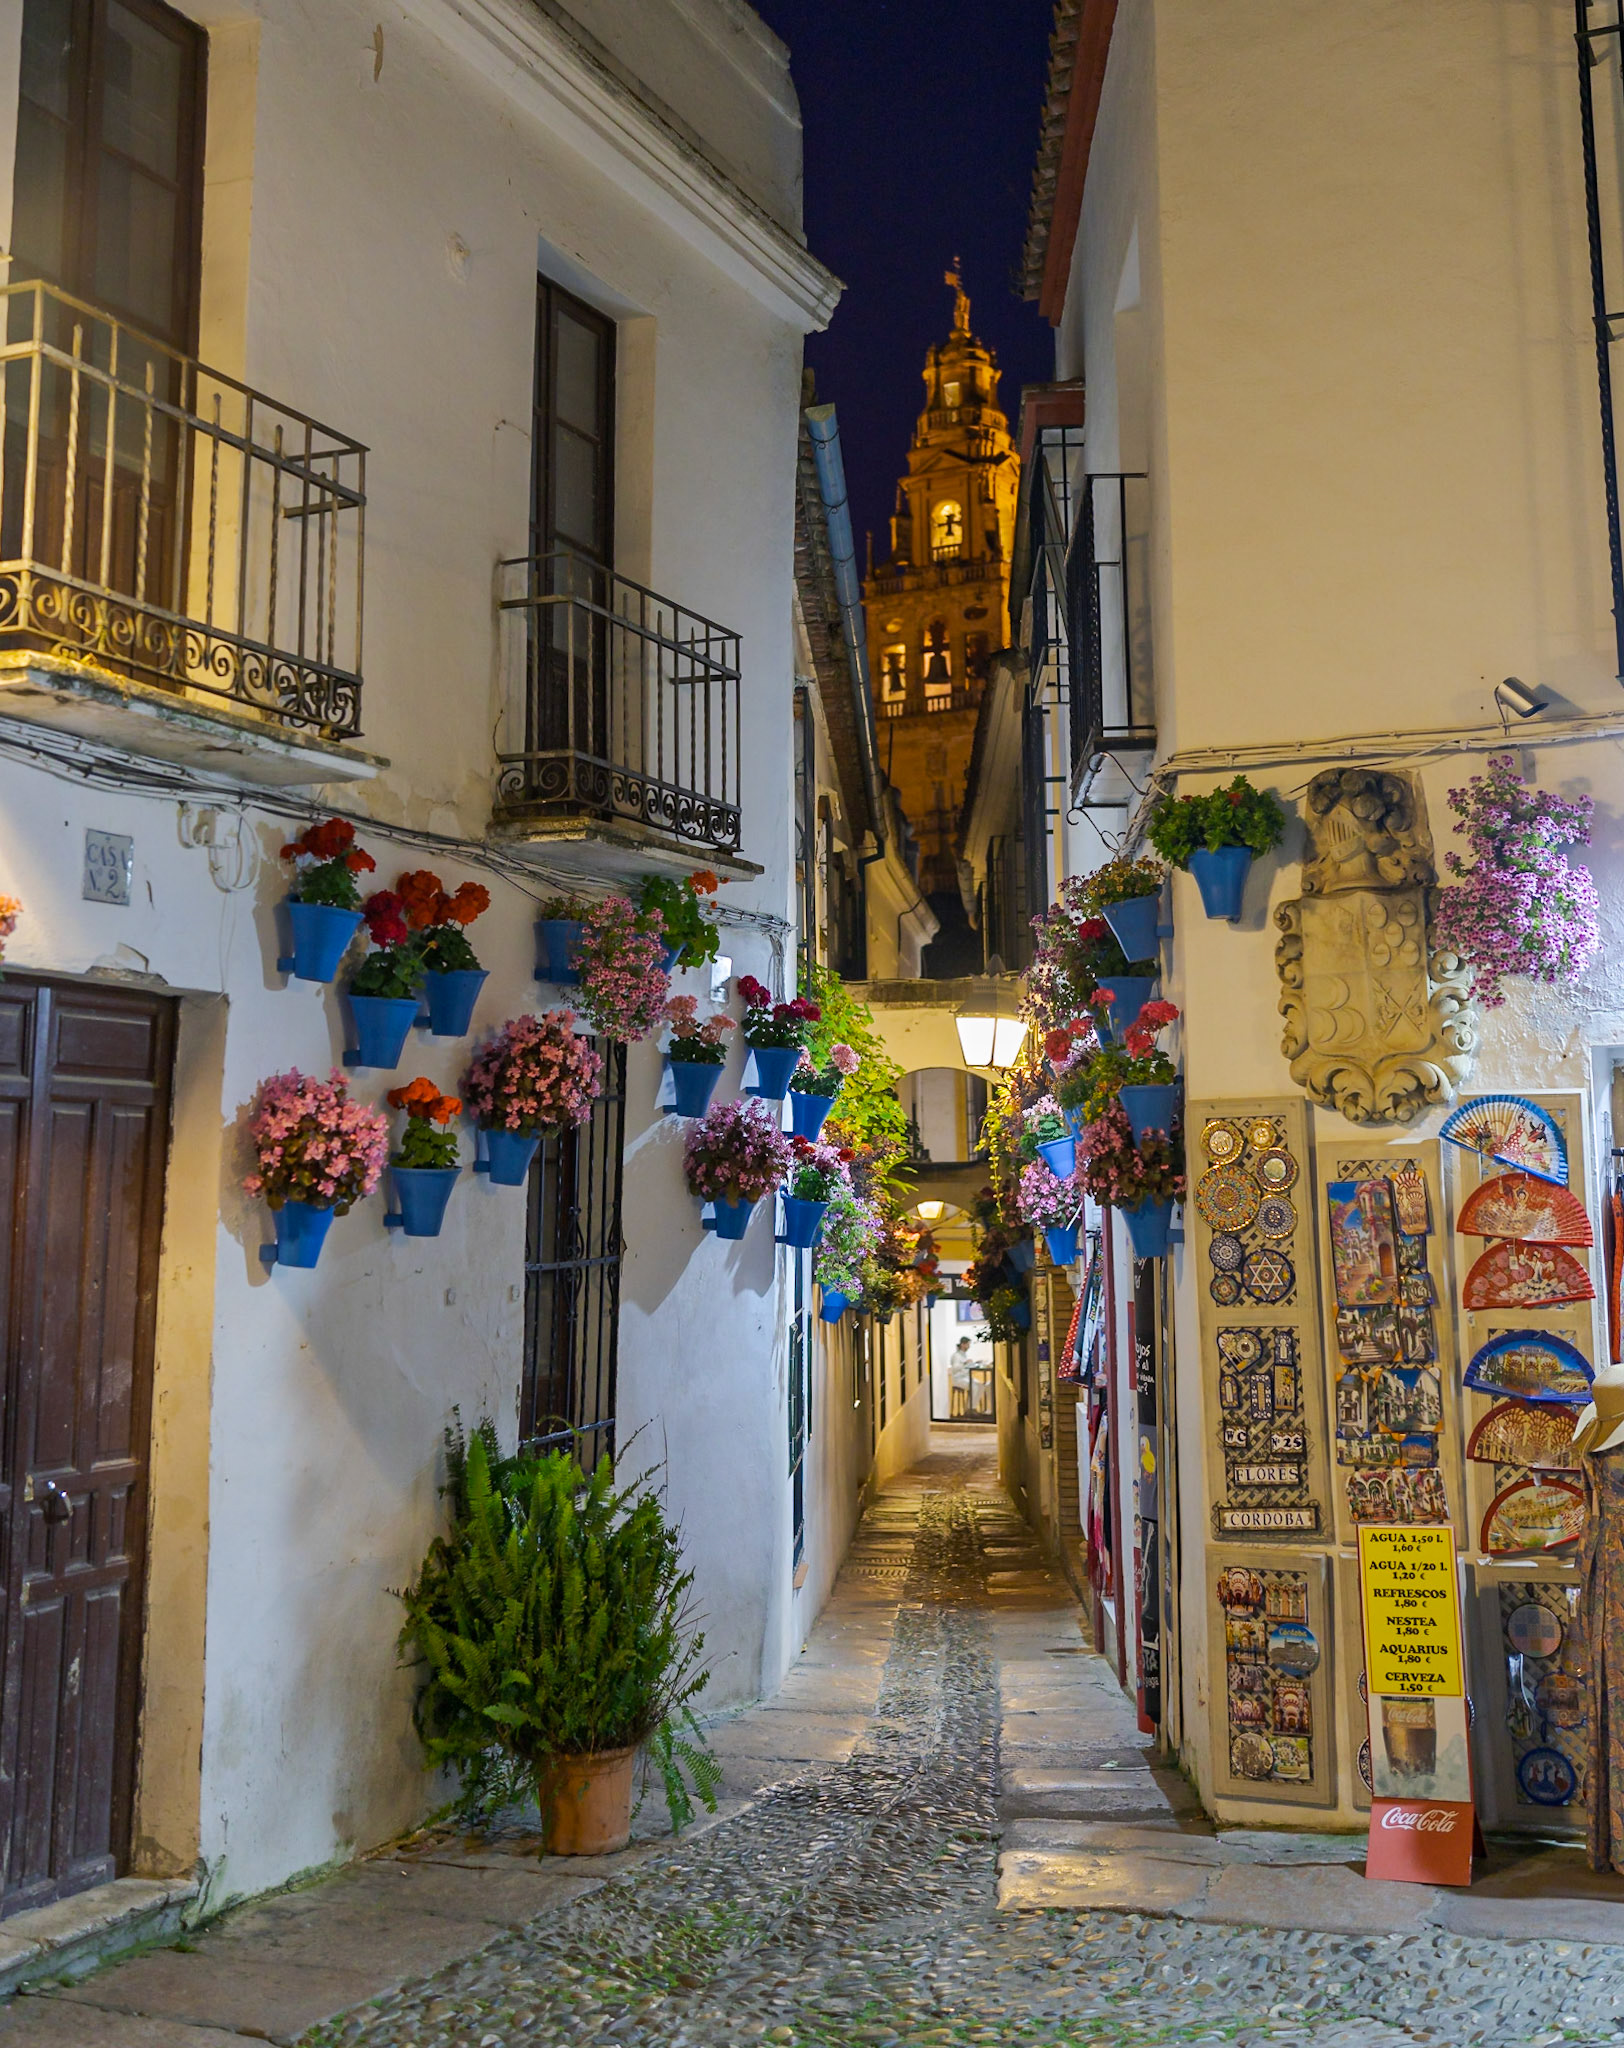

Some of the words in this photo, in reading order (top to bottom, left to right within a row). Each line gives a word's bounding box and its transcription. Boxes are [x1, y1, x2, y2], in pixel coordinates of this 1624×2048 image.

[1226, 1430, 1247, 1443] WC
[1283, 1437, 1302, 1448] 25
[1235, 1467, 1299, 1481] FLORES
[1230, 1512, 1305, 1527] CORDOBA
[1370, 1532, 1407, 1543] AGUA
[1411, 1535, 1434, 1544] 1,50
[1393, 1544, 1414, 1553] 1,60
[1369, 1560, 1407, 1570] AGUA
[1411, 1562, 1437, 1571] 1/20
[1393, 1571, 1416, 1581] 1,20
[1373, 1588, 1447, 1599] REFRESCOS
[1394, 1599, 1418, 1608] 1,80
[1386, 1616, 1438, 1626] NESTEA
[1396, 1627, 1420, 1636] 1,80
[1424, 1628, 1430, 1636] €
[1379, 1644, 1448, 1655] AQUARIUS
[1397, 1655, 1421, 1664] 1,80
[1426, 1656, 1431, 1664] €
[1385, 1672, 1446, 1683] CERVEZA
[1400, 1683, 1423, 1693] 1,50
[1381, 1807, 1460, 1833] Coca-Cola
